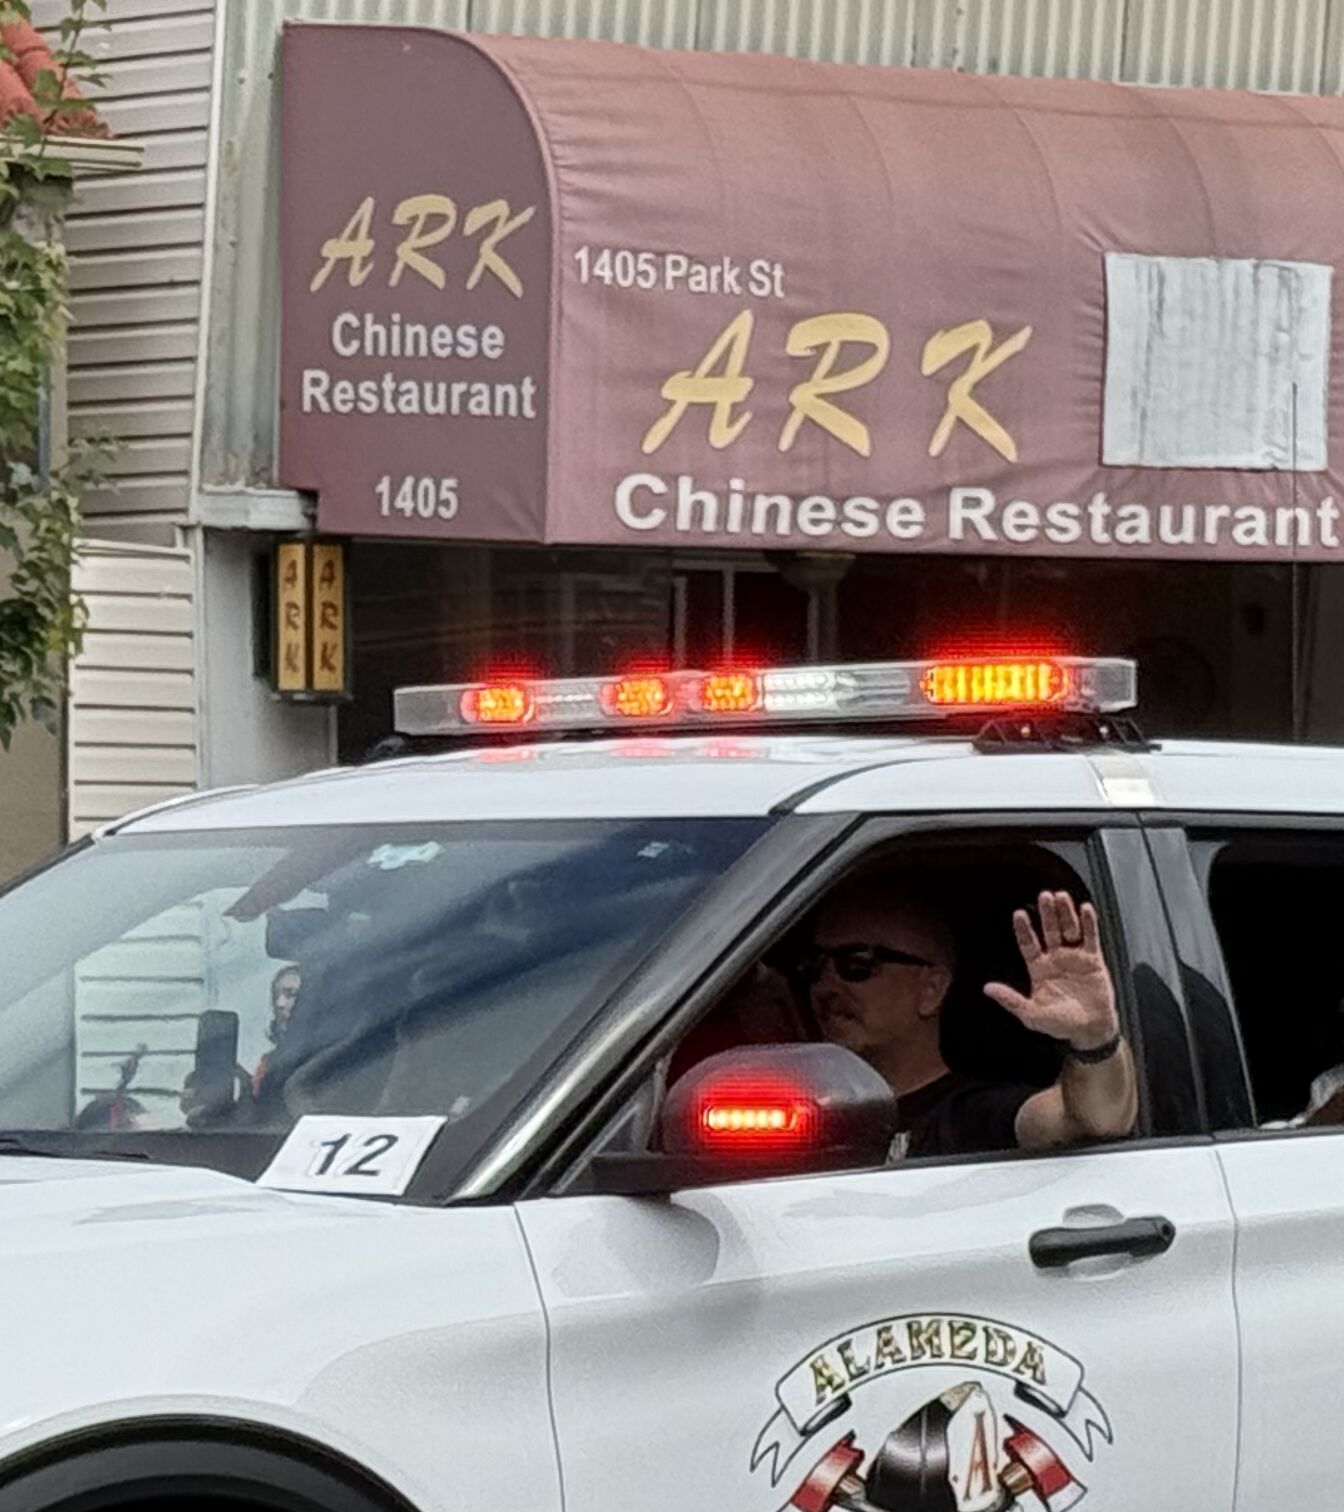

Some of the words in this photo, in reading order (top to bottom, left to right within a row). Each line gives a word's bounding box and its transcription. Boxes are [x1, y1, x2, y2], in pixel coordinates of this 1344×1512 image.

[310, 194, 537, 299] ARK
[575, 246, 656, 290] 1405
[664, 255, 742, 295] Park
[749, 259, 785, 298] St
[332, 312, 505, 359] Chinese
[302, 369, 537, 419] Restaurant
[642, 310, 1033, 463] ARK
[375, 475, 458, 519] 1405
[614, 473, 926, 538] Chinese
[947, 486, 1341, 548] Restaurant
[319, 559, 339, 674] ARK
[316, 1132, 399, 1177] 12
[810, 1318, 1047, 1407] ALAMEDA
